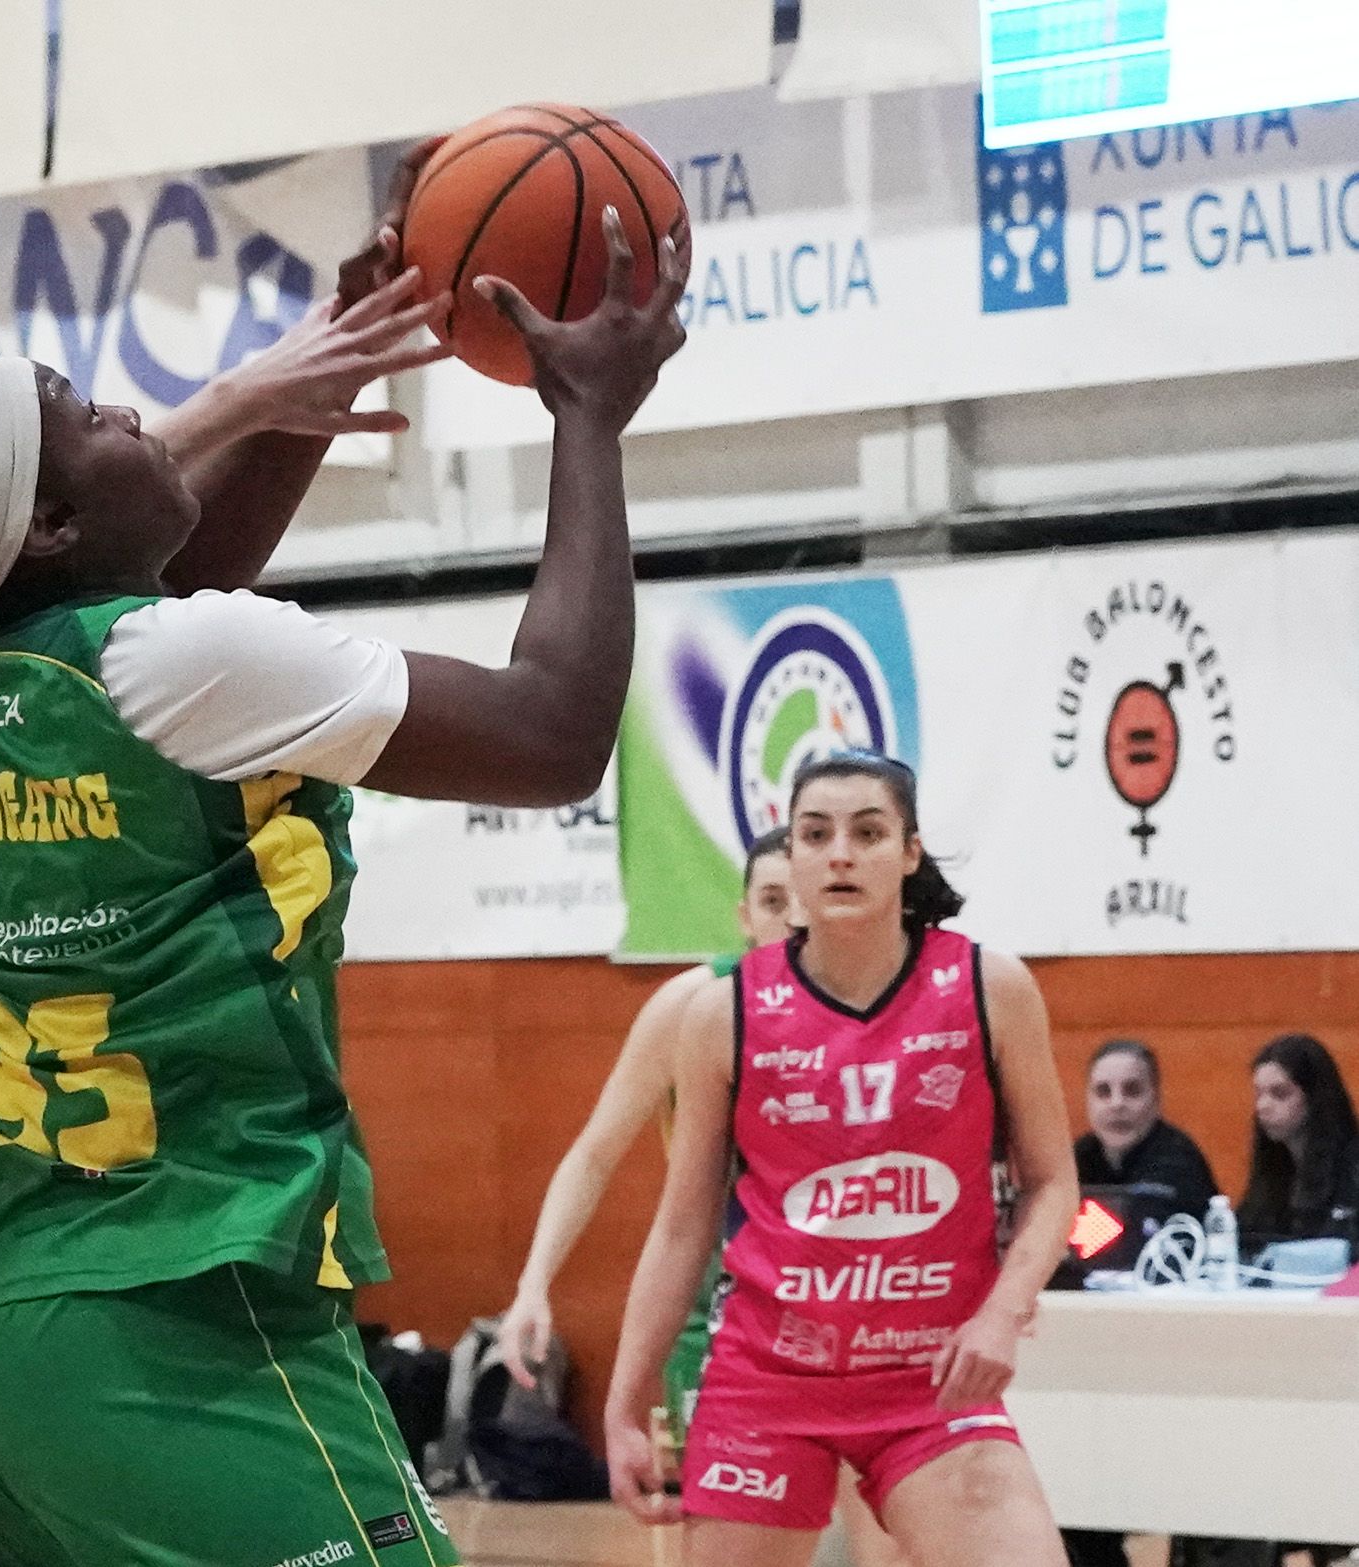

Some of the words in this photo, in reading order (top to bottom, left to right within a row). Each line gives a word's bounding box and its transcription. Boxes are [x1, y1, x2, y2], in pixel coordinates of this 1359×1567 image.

[1091, 203, 1169, 281] DE
[1185, 170, 1359, 269] GALIC
[1051, 654, 1091, 770] CLUB
[1084, 579, 1239, 764] BALONCESTO
[753, 1045, 827, 1072] enjoy!
[839, 1059, 897, 1127] 17
[806, 1166, 940, 1224] ABRIL
[774, 1254, 958, 1302] avilés
